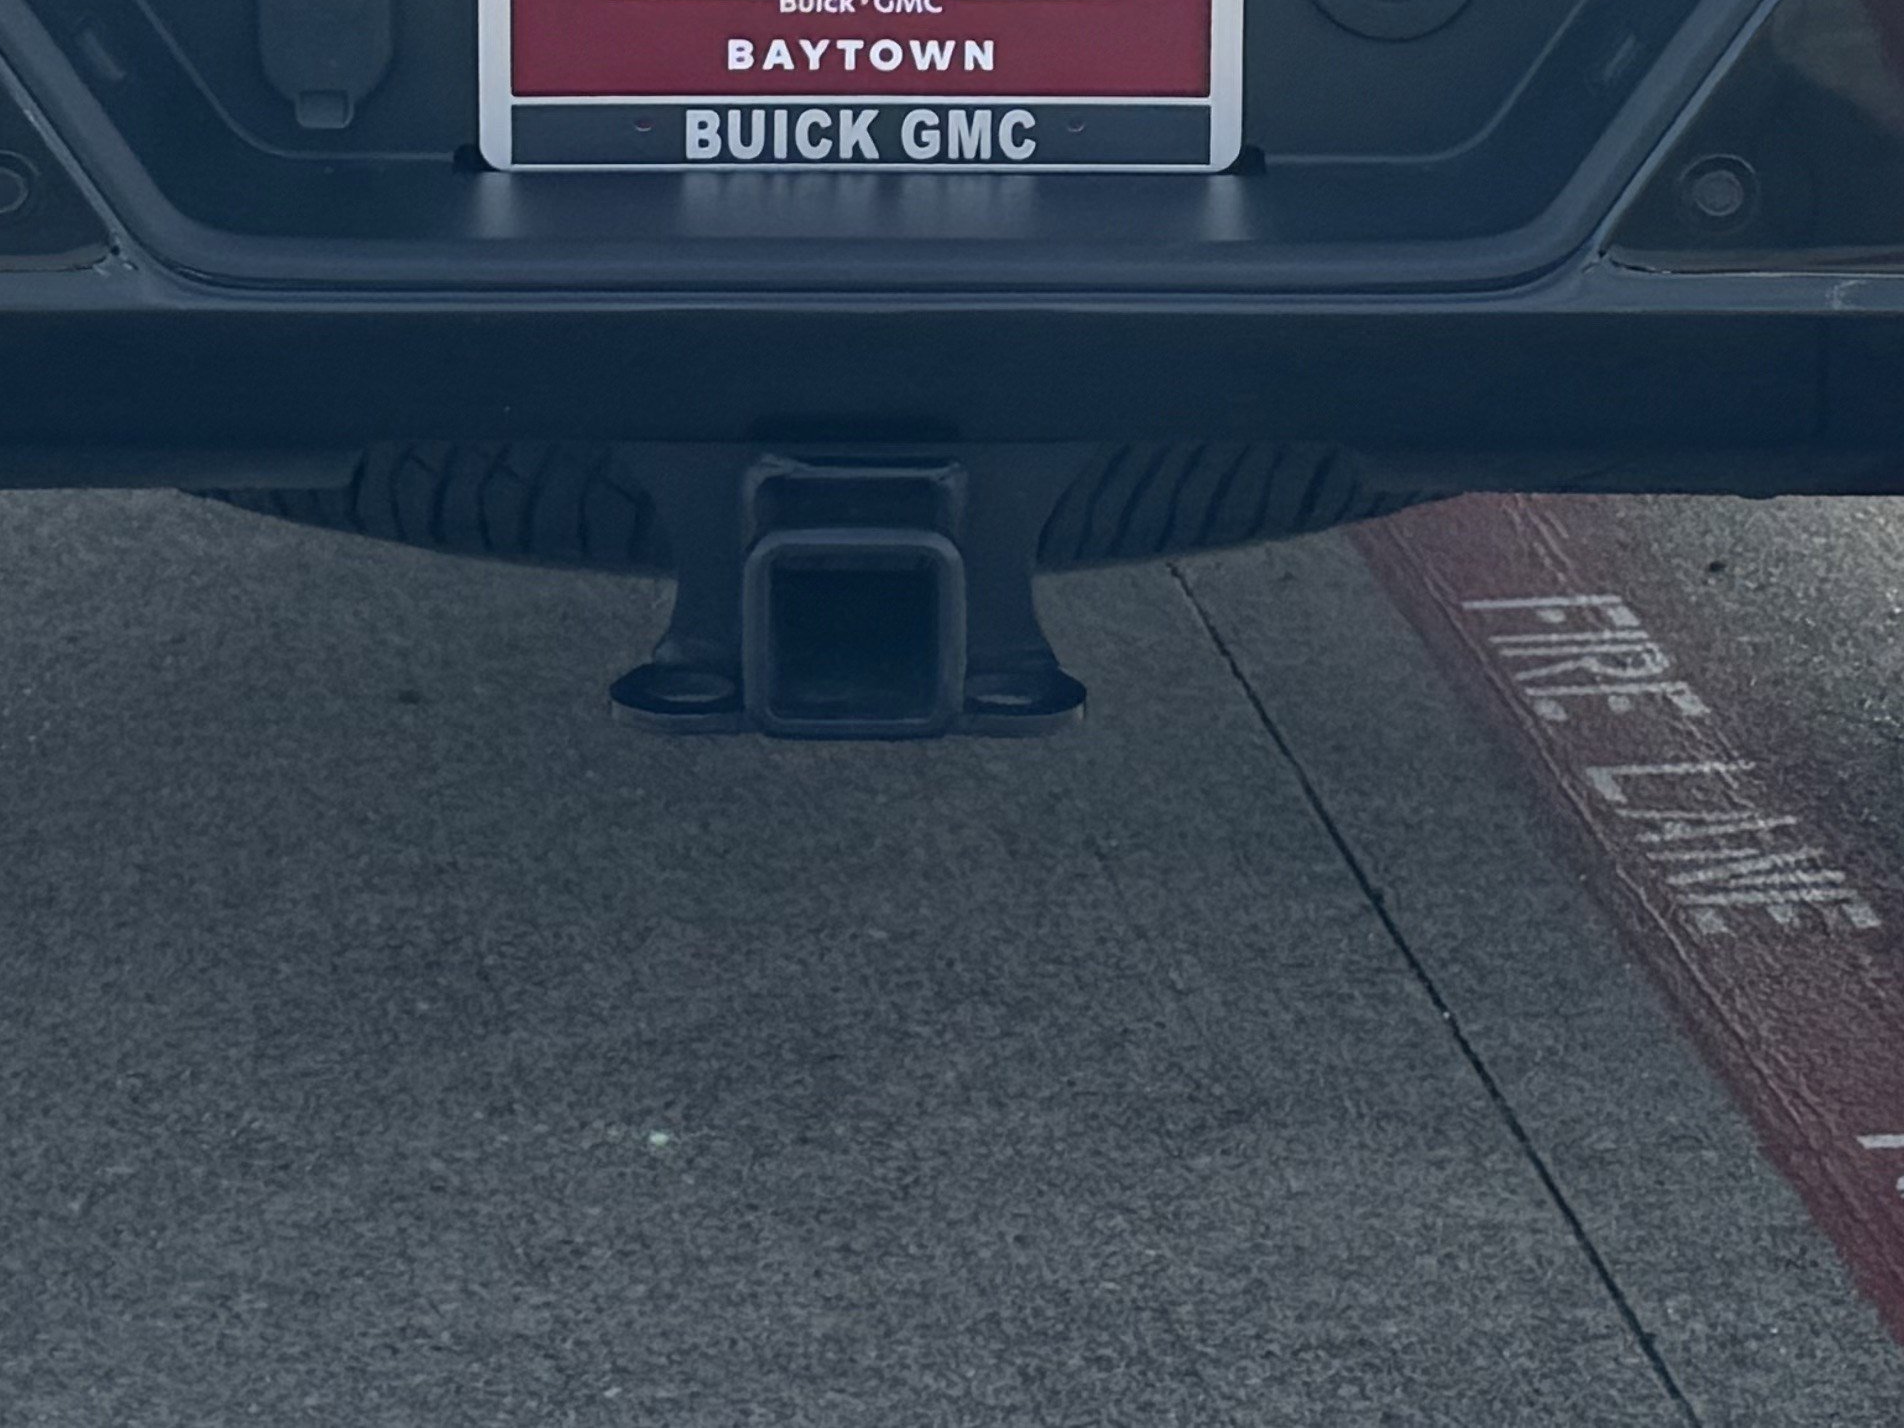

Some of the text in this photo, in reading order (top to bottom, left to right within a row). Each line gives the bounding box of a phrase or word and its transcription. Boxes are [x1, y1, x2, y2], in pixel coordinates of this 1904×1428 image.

[727, 38, 996, 72] BAYTOWN
[684, 109, 1038, 161] BUICK GMC
[1462, 595, 1711, 722] FIRE
[1585, 760, 1882, 937] LANE
